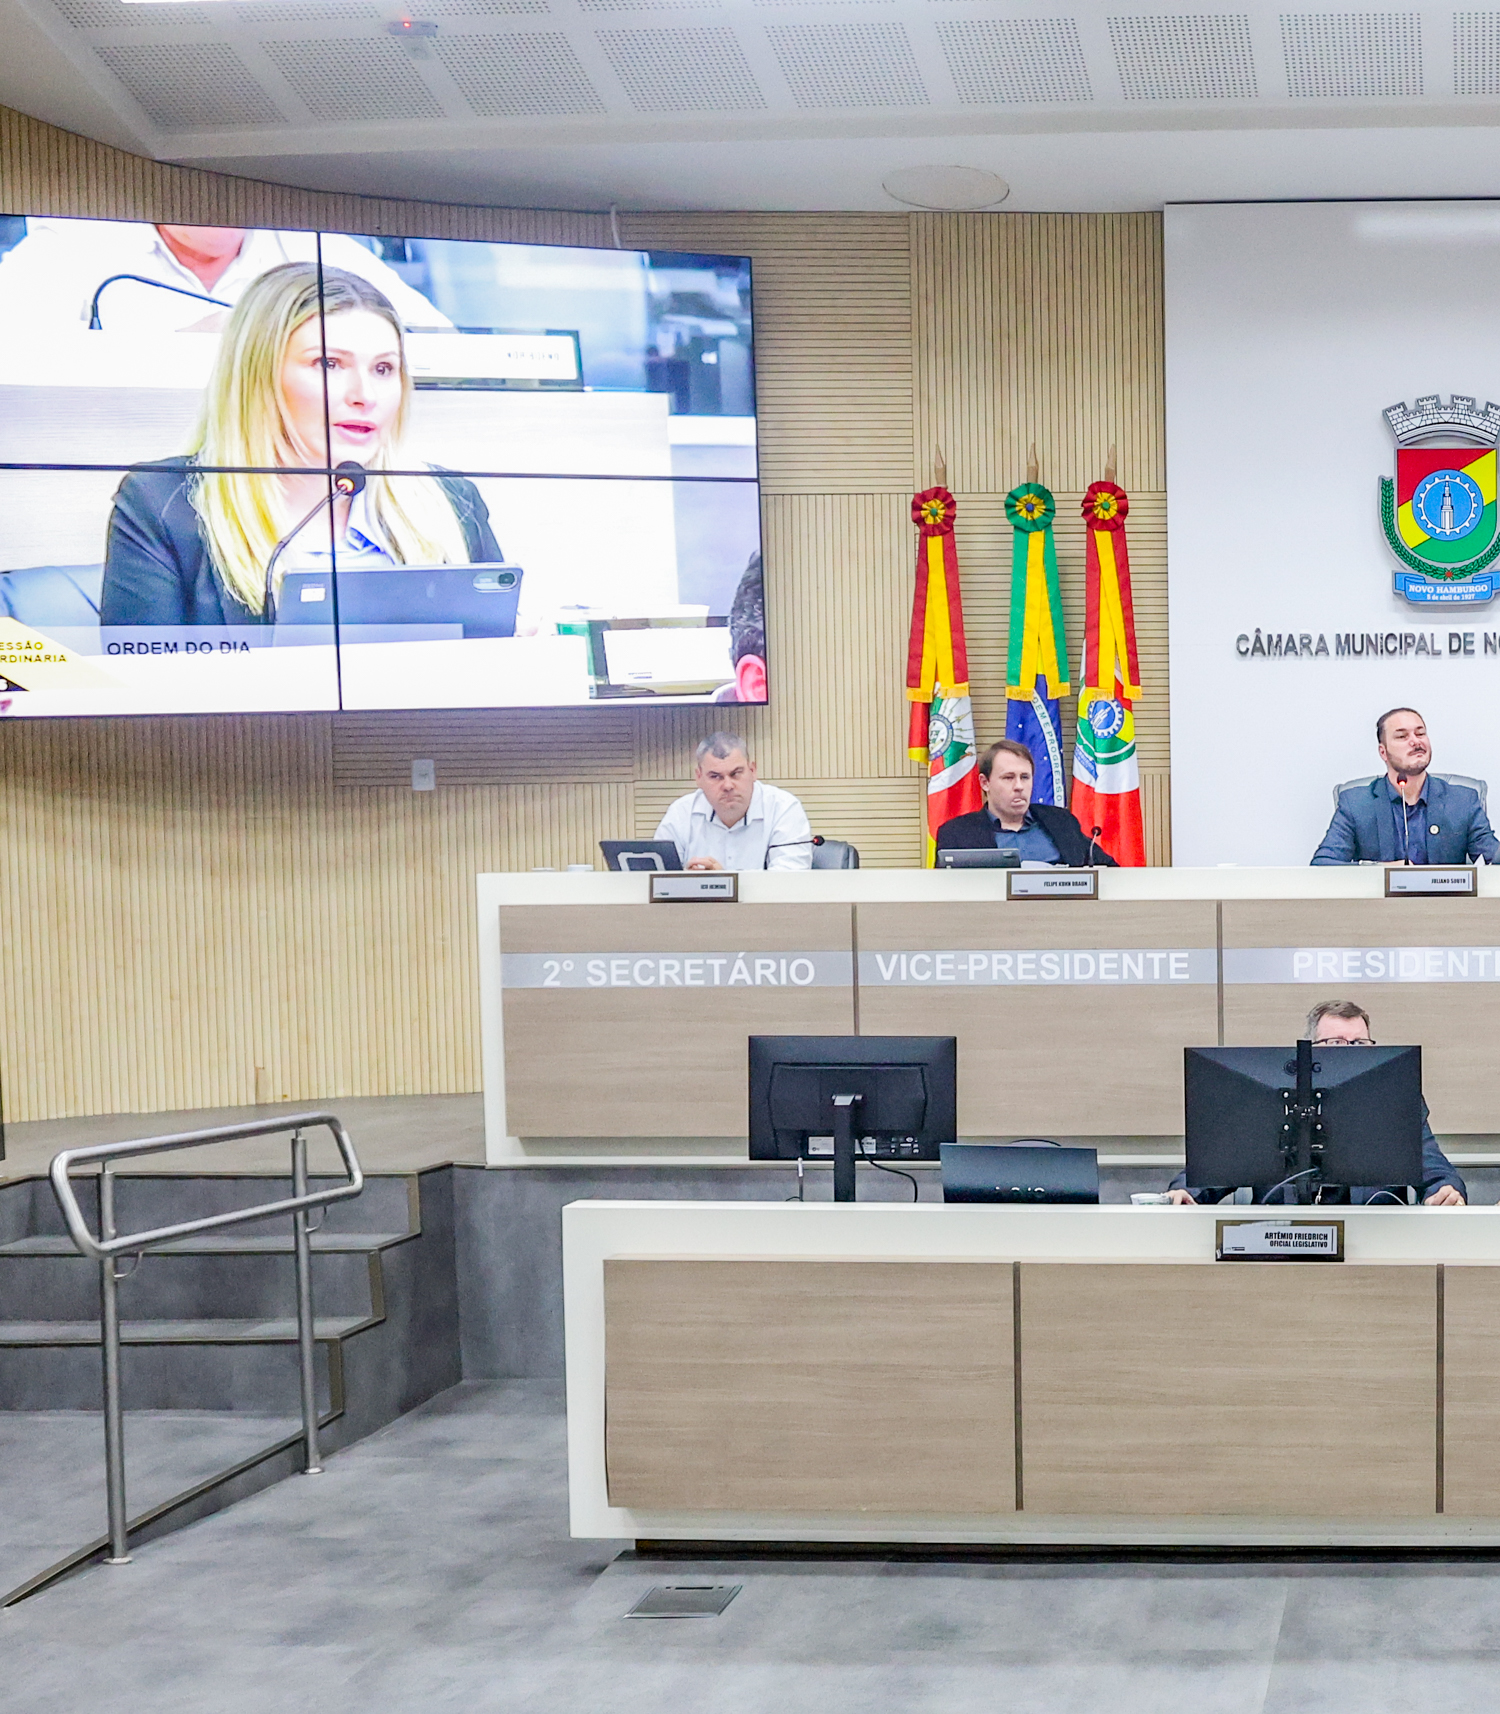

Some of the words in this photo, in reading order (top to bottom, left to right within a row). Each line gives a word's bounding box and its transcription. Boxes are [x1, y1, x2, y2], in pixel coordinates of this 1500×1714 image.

[1409, 585, 1434, 593] NOVO
[1437, 585, 1488, 593] HAMBURGO
[107, 642, 178, 655] ORDEM
[185, 642, 212, 654] DO
[219, 641, 250, 654] DIA
[1235, 628, 1330, 656] CÂMARA
[1335, 632, 1441, 656] MUNICIPAL
[1448, 632, 1475, 656] DE
[1046, 730, 1062, 801] PROGRESSO
[586, 952, 815, 987] SECRETÁRIO
[875, 952, 1190, 981] VICE-PRESIDENTE
